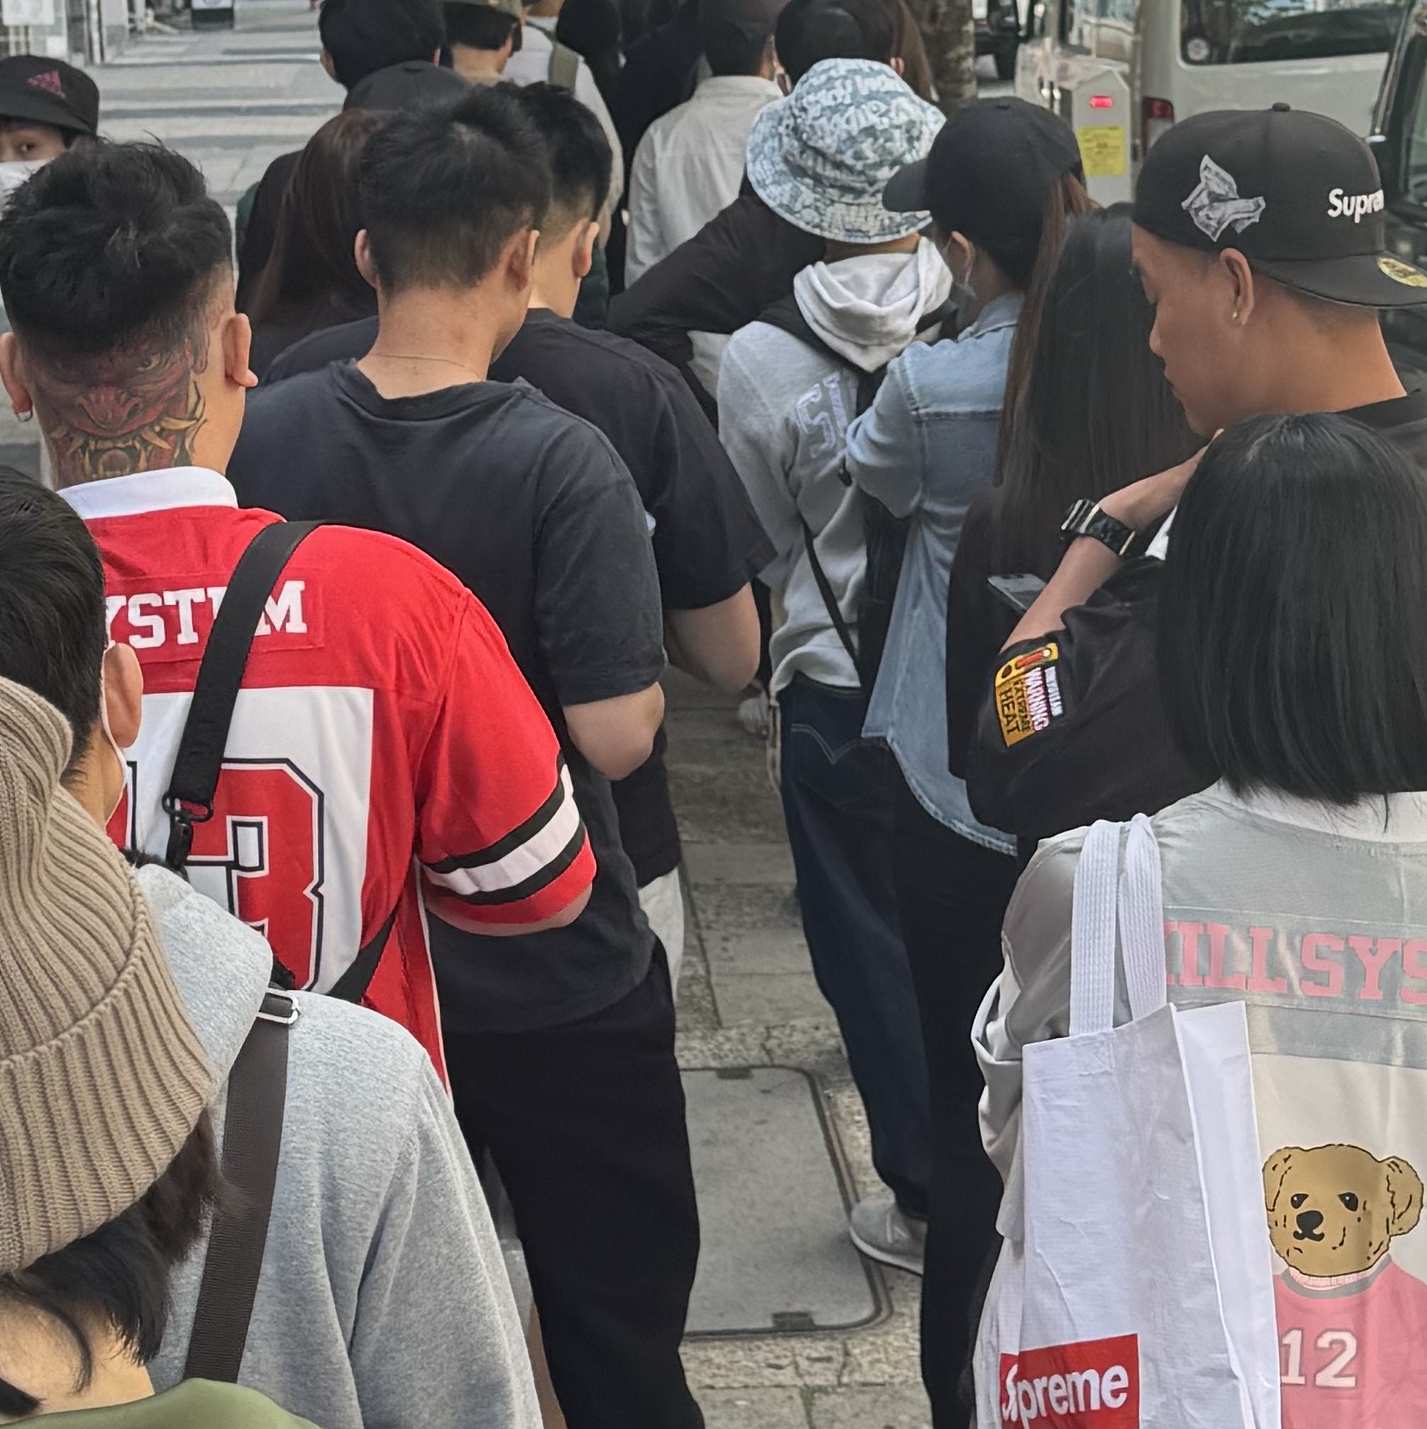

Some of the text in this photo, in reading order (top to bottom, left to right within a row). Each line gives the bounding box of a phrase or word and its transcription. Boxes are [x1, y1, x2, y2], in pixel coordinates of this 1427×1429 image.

[999, 688, 1020, 734] HEAT
[1024, 666, 1050, 731] WARNING
[1280, 1329, 1358, 1388] 12
